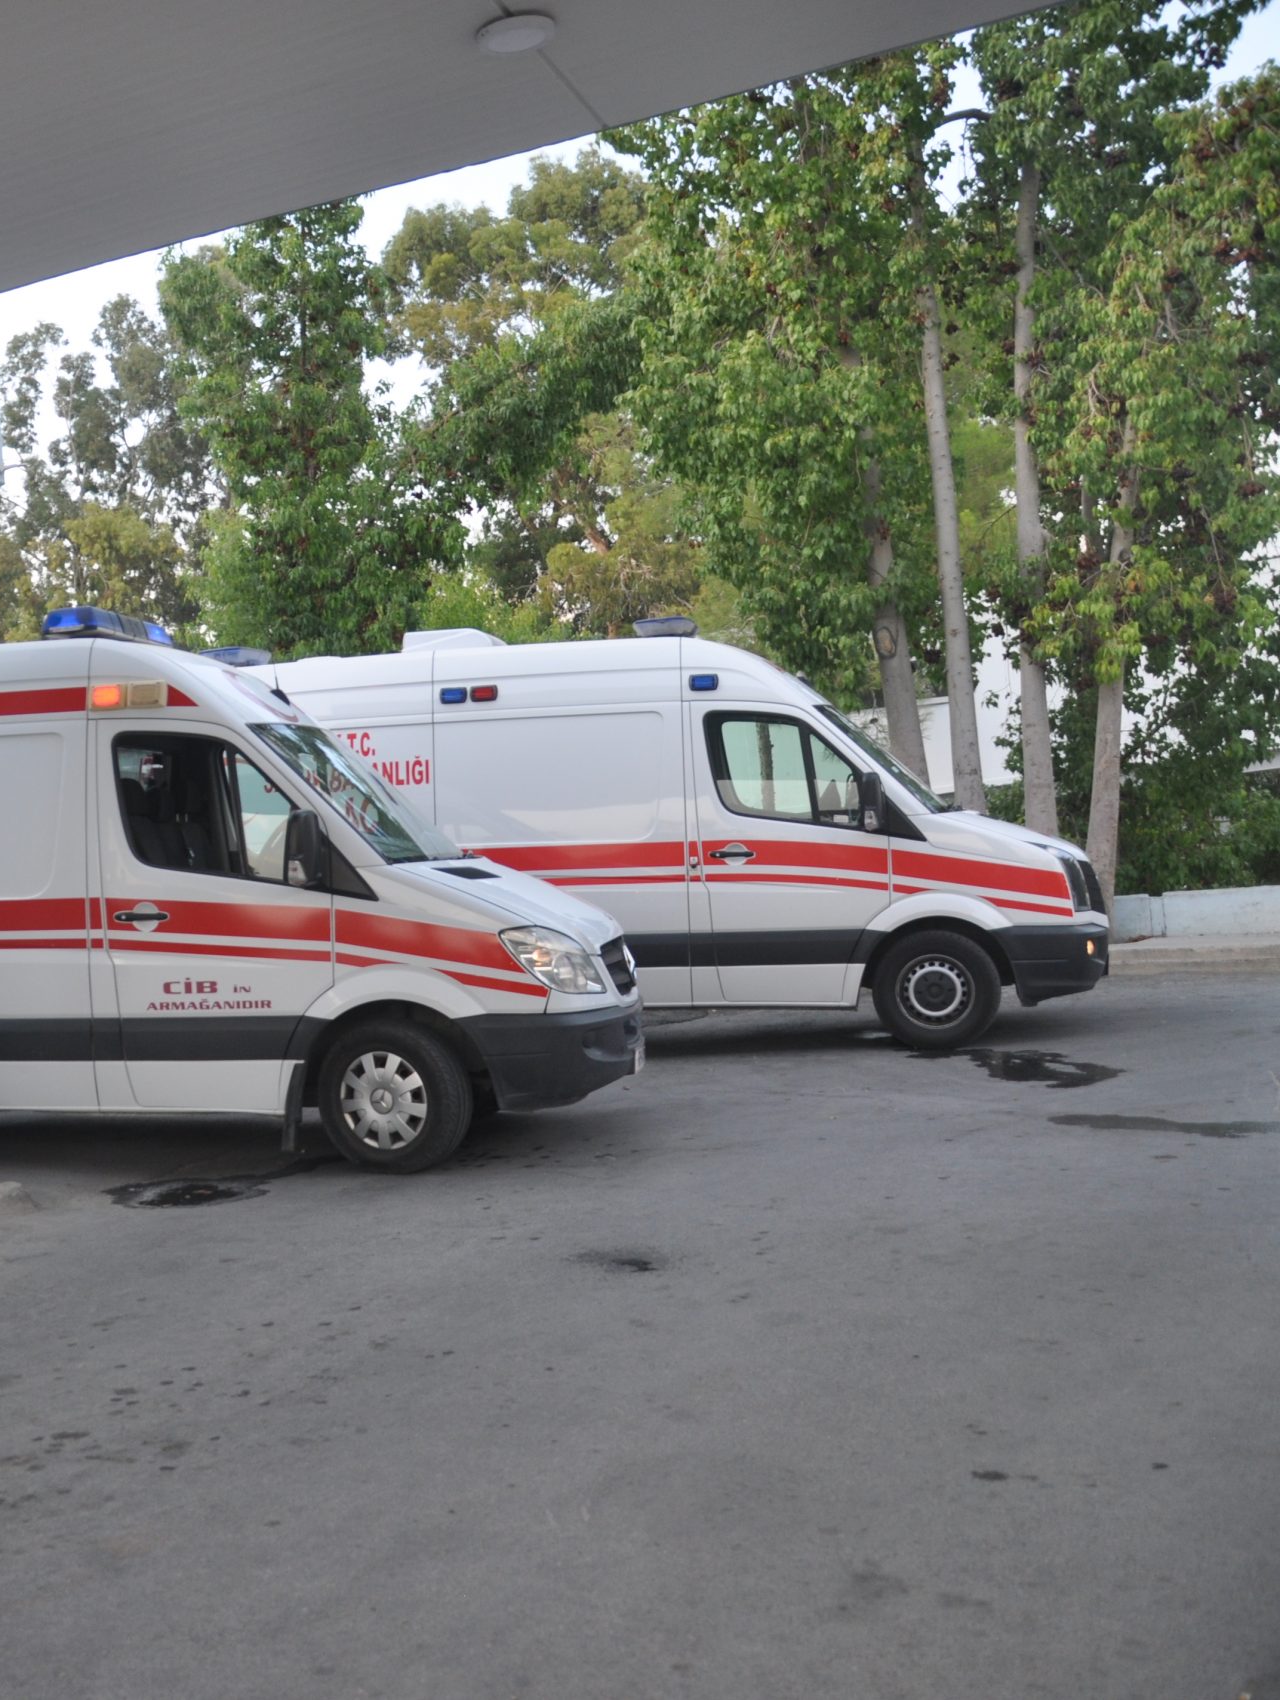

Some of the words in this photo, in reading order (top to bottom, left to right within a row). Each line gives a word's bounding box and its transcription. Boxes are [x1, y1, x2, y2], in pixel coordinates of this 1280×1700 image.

[337, 732, 376, 756] T.C.
[163, 977, 218, 995] CİB
[146, 998, 272, 1011] ARMAĞANIDIR
